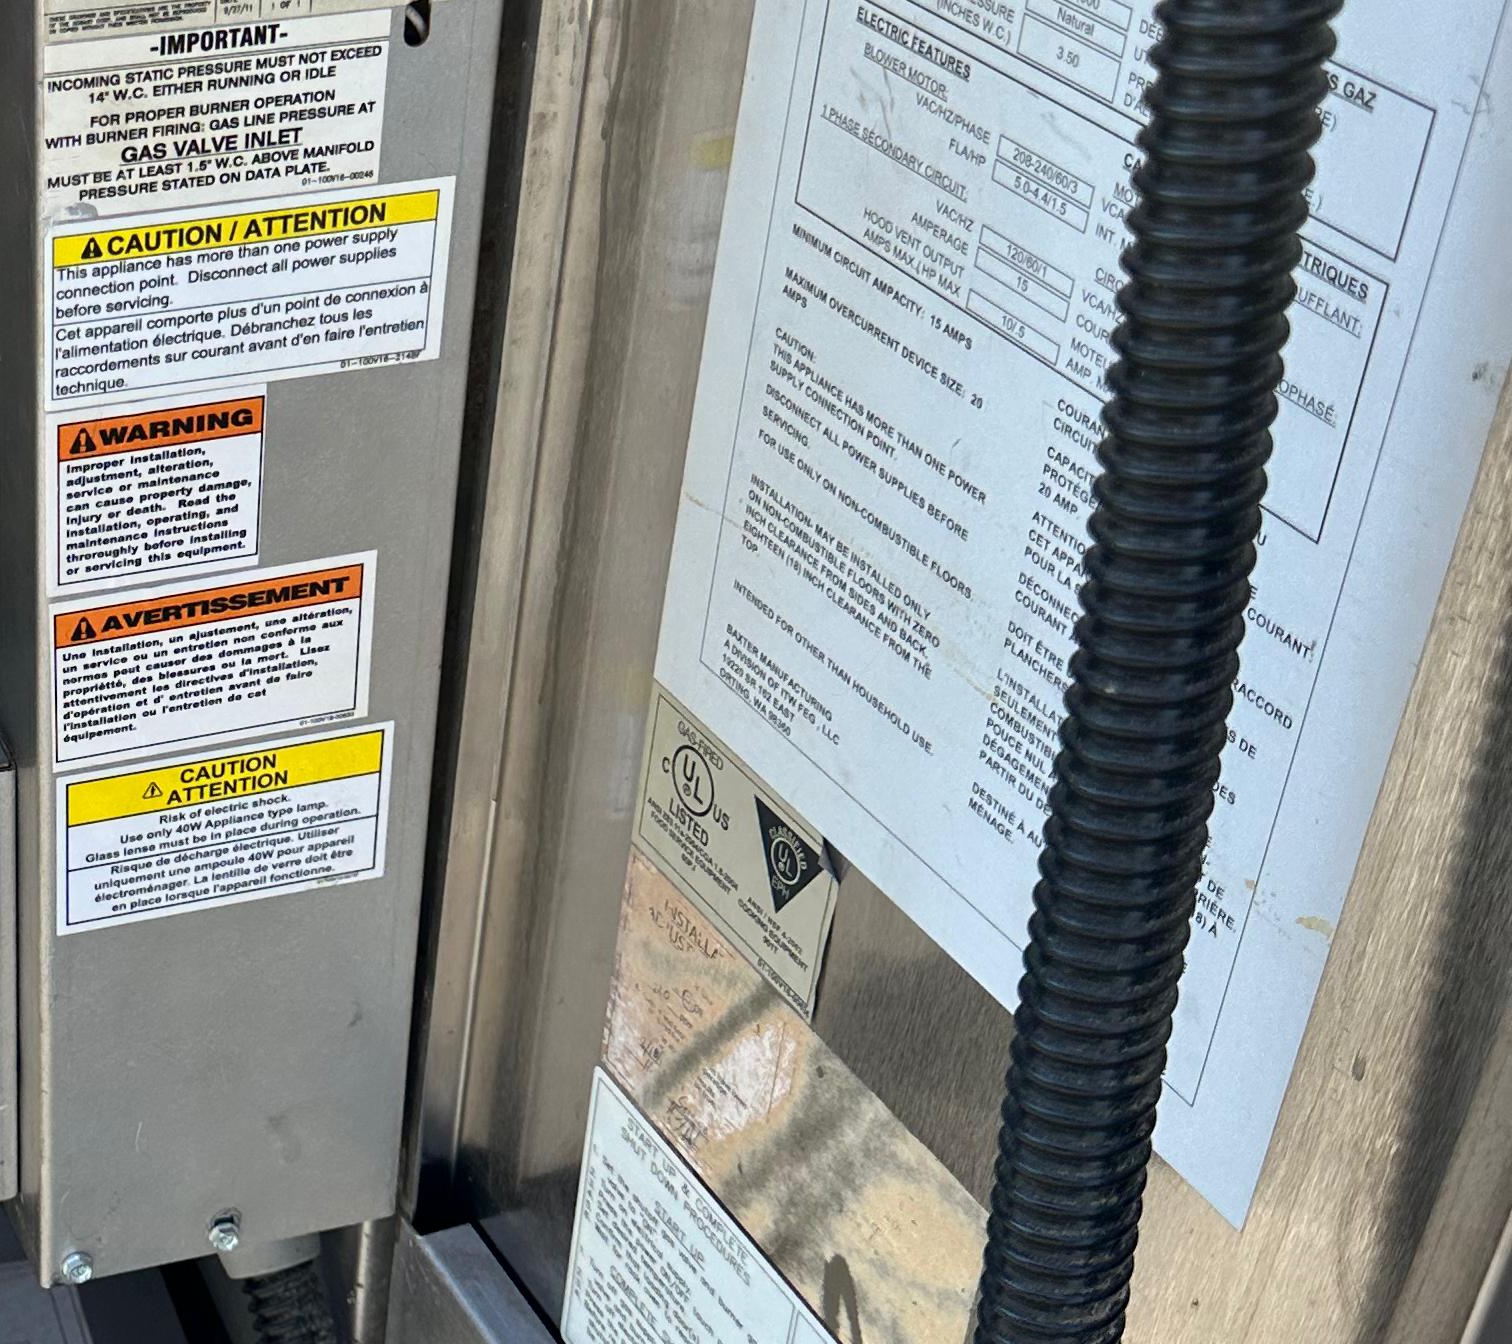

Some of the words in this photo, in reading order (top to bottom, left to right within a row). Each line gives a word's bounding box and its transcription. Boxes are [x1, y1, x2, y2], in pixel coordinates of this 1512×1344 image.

[150, 23, 287, 55] -IMPORTANT-
[1056, 6, 1094, 36] Natural
[857, 6, 909, 44] ELECTRIC
[910, 34, 970, 80] FEATURES
[1056, 46, 1079, 68] 3.50
[47, 74, 120, 92] INCOMING
[125, 67, 173, 84] STATIC
[177, 59, 252, 78] PRESSURE
[255, 54, 295, 69] MUST
[298, 50, 327, 64] NOT
[330, 45, 382, 61] EXCEED
[89, 91, 109, 103] 14"
[112, 86, 147, 101] W.C.
[152, 80, 202, 96] EITHER
[207, 72, 275, 91] RUNNING
[279, 69, 300, 82] OR
[305, 65, 336, 80] IDLE
[45, 134, 81, 149] WITH
[86, 127, 148, 145] BURNER
[152, 121, 204, 137] FIRING:
[209, 116, 239, 131] GAS
[243, 112, 275, 127] LINE
[279, 103, 355, 123] PRESSURE
[357, 100, 376, 114] AT
[90, 113, 120, 127] FOR
[125, 106, 185, 123] PROPER
[189, 99, 249, 116] BURNER
[253, 89, 335, 109] OPERATION
[916, 92, 990, 144] VAC/HZ/PHASE
[121, 142, 166, 163] GAS
[173, 134, 237, 157] VALVE
[245, 126, 303, 148] INLET
[948, 138, 986, 166] FLA/HP
[47, 172, 90, 188] MUST
[93, 170, 112, 183] BE
[115, 168, 134, 181] AT
[138, 162, 182, 178] LEAST
[187, 159, 212, 172] 1.5"
[214, 155, 247, 169] W.C.
[251, 148, 299, 165] ABOVE
[303, 140, 374, 159] MANIFOLD
[79, 181, 157, 201] PRESSURE
[161, 174, 215, 191] STATED
[219, 171, 240, 184] ON
[245, 166, 281, 181] DATA
[285, 161, 330, 176] PLATE.
[106, 222, 222, 255] CAUTION
[229, 220, 238, 241] /
[243, 202, 388, 239] ATTENTION
[910, 212, 968, 255] AMPERAGE
[936, 199, 974, 232] VAC/HZ
[56, 281, 134, 300] connection
[139, 273, 174, 292] point.
[188, 262, 267, 283] Disconnect
[271, 258, 288, 272] all
[292, 255, 336, 272] power
[339, 246, 396, 264] supplies
[57, 267, 87, 280] This
[91, 259, 161, 278] appliance
[166, 255, 192, 267] has
[196, 249, 233, 263] more
[238, 245, 269, 258] than
[273, 241, 300, 254] one
[304, 235, 349, 253] power
[352, 228, 398, 244] supply
[1006, 243, 1048, 278] 120/60/1
[792, 223, 832, 257] MINIMUM
[833, 251, 871, 282] CIRCUIT
[930, 315, 941, 329] 15
[942, 323, 972, 350] AMPS
[1015, 275, 1029, 292] 15
[55, 303, 101, 319] before
[105, 295, 172, 312] servicing.
[98, 408, 252, 446] WARNING
[66, 458, 124, 473] Improper
[130, 447, 205, 464] installation,
[66, 468, 142, 486] adjustment,
[147, 459, 213, 474] alteration,
[66, 486, 113, 499] service
[118, 483, 132, 491] or
[137, 470, 219, 489] maintenance
[100, 576, 350, 632] AVERTISSEMENT
[678, 721, 723, 770] GAS-FIRED
[166, 770, 290, 805] ATTENTION
[180, 755, 276, 783] CAUTION
[159, 812, 185, 824] Risk
[189, 808, 202, 819] of
[204, 802, 248, 816] electric
[252, 794, 290, 807] shock.
[670, 798, 708, 847] LISTED
[713, 804, 730, 831] US
[621, 1127, 646, 1160] SHUT
[650, 1161, 678, 1200] DOWN
[683, 1200, 749, 1286] PROCEDURES
[627, 1117, 658, 1157] START
[662, 1159, 676, 1176] UP
[680, 1183, 689, 1198] &
[695, 1197, 747, 1265] COMPLETE
